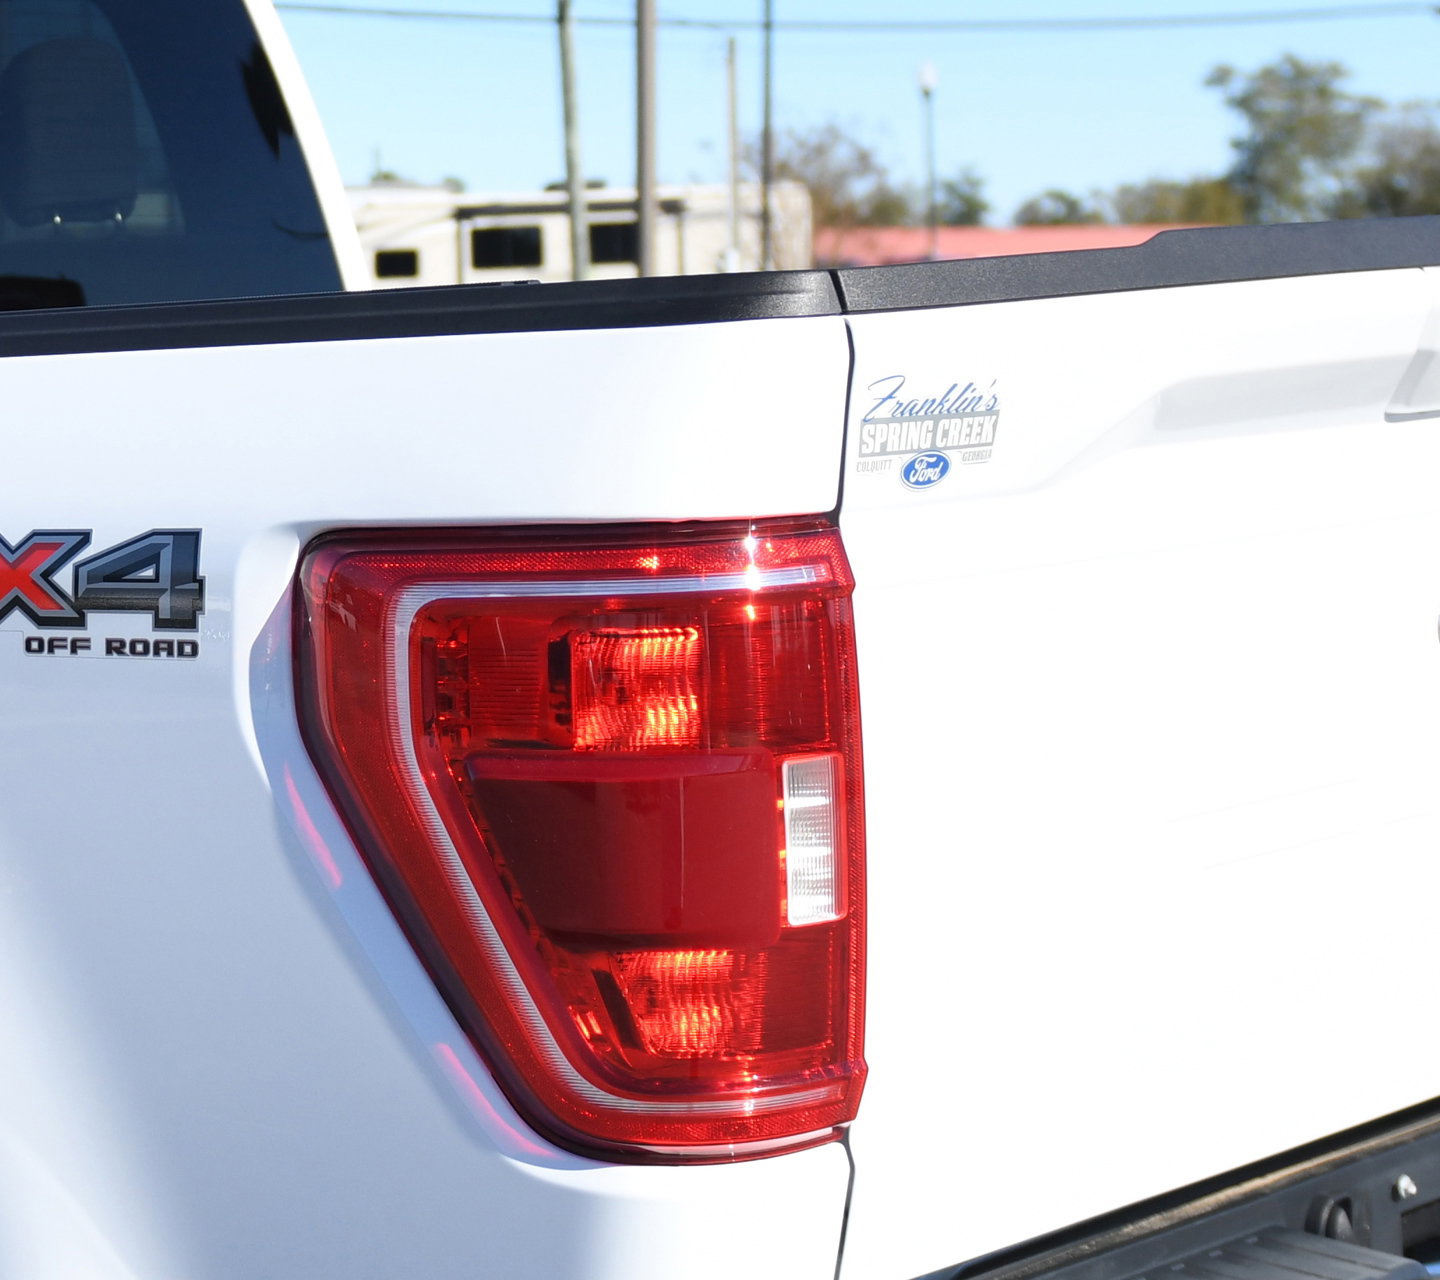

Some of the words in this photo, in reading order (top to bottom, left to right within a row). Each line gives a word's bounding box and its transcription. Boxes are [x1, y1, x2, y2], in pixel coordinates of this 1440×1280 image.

[862, 375, 1001, 423] Franklin's
[861, 420, 934, 455] SPRING
[935, 414, 998, 448] CREEK
[908, 456, 944, 483] Ford
[24, 636, 93, 656] OFF
[104, 637, 201, 659] ROAD
